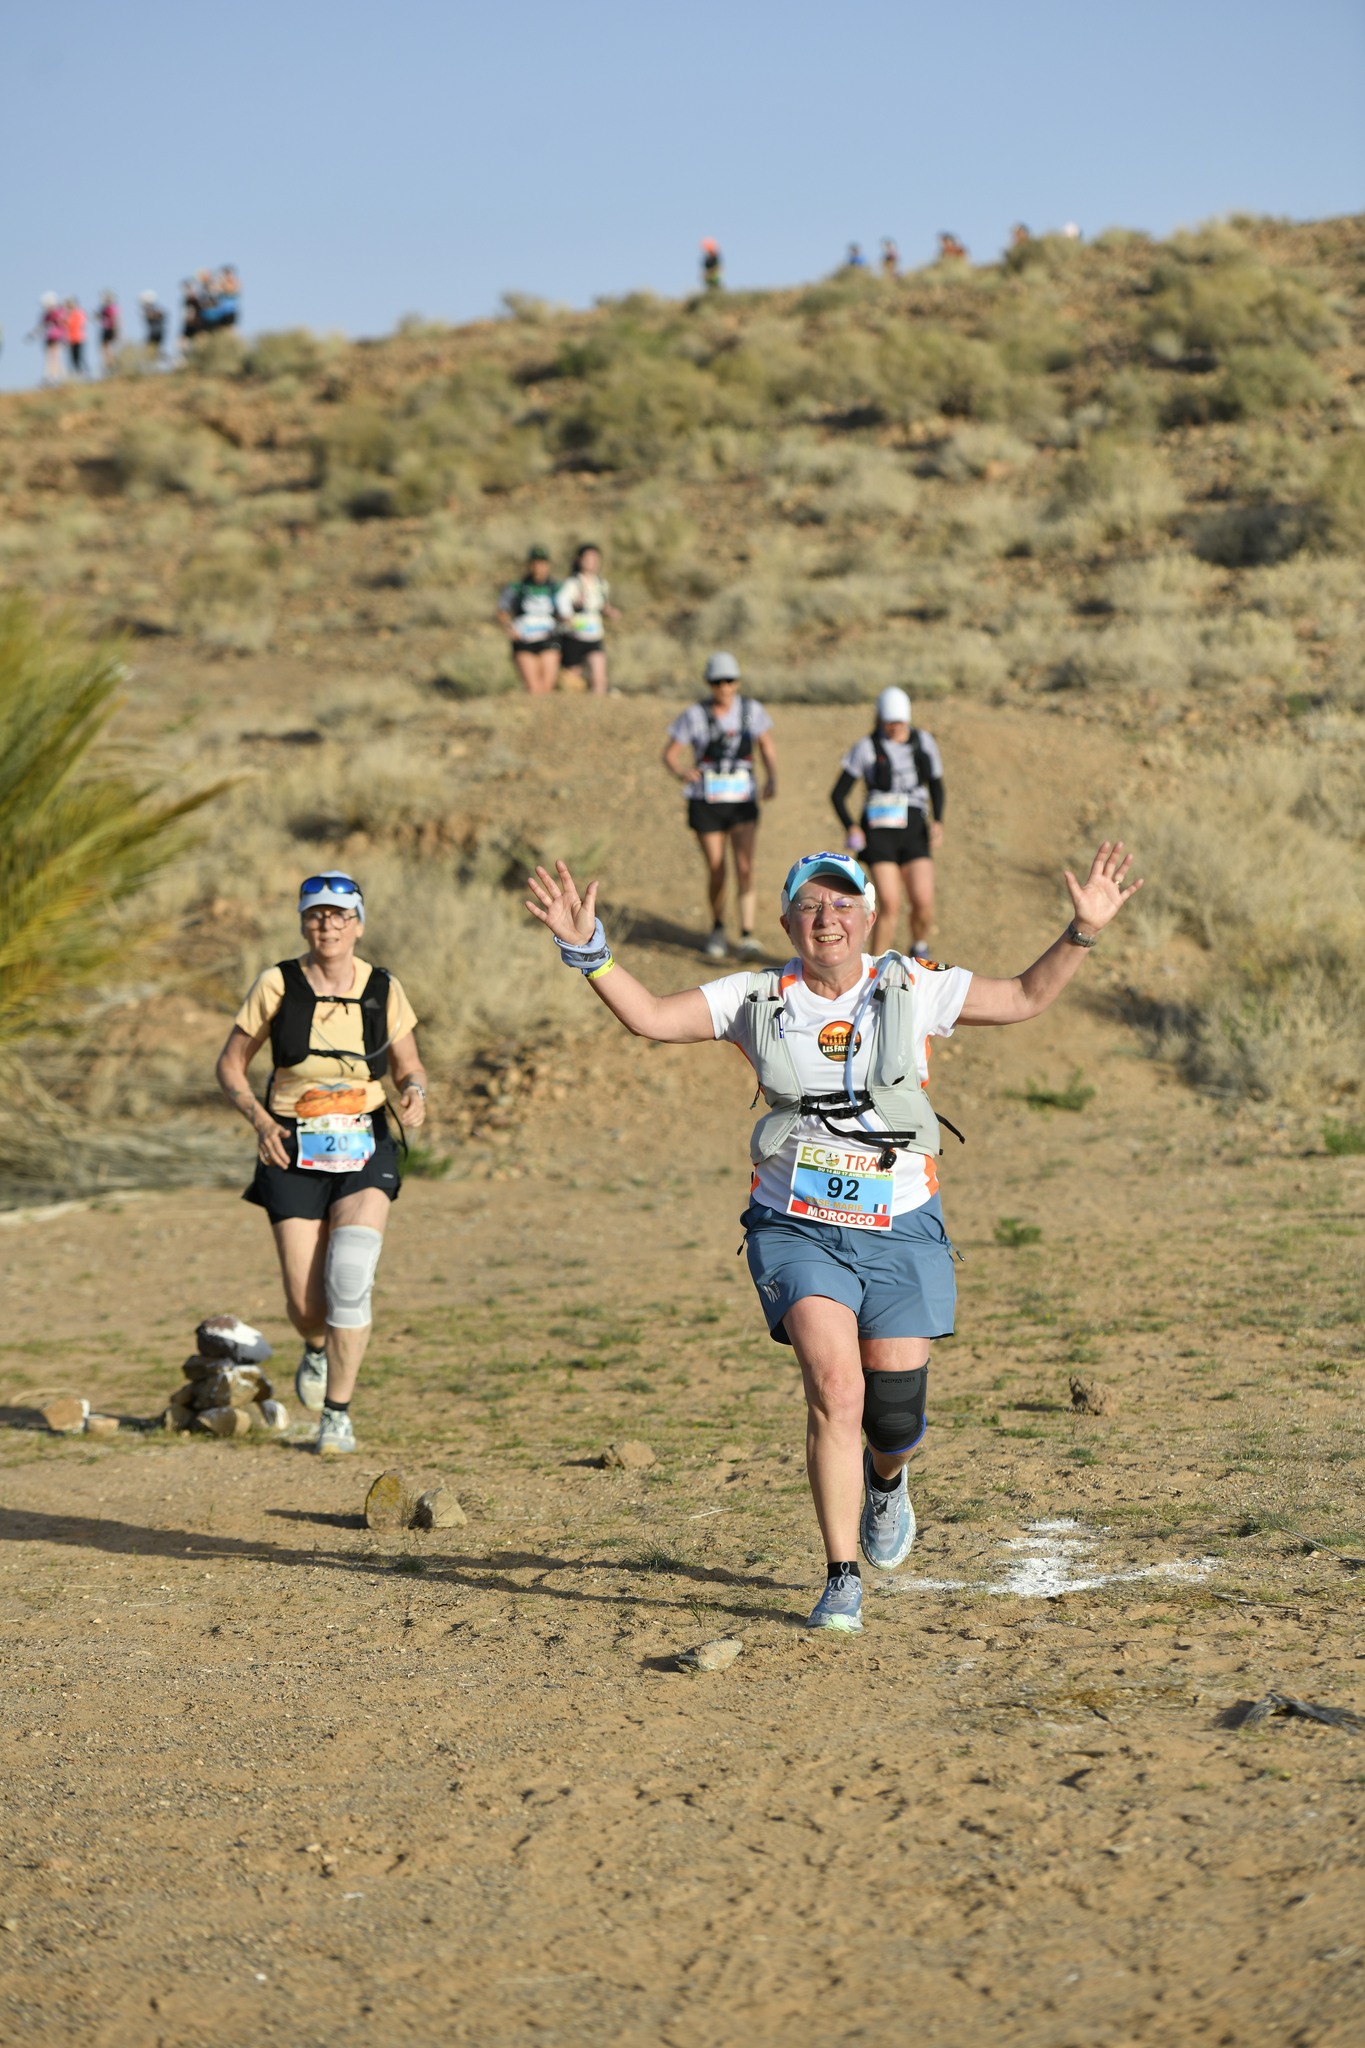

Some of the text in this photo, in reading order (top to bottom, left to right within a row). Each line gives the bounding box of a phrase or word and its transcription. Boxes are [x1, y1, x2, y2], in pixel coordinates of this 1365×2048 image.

[822, 1045, 834, 1053] LES
[325, 1136, 349, 1152] 20
[827, 1177, 860, 1201] 92
[805, 1195, 863, 1211] ROSE-MARIE
[807, 1205, 875, 1225] MOROCCO
